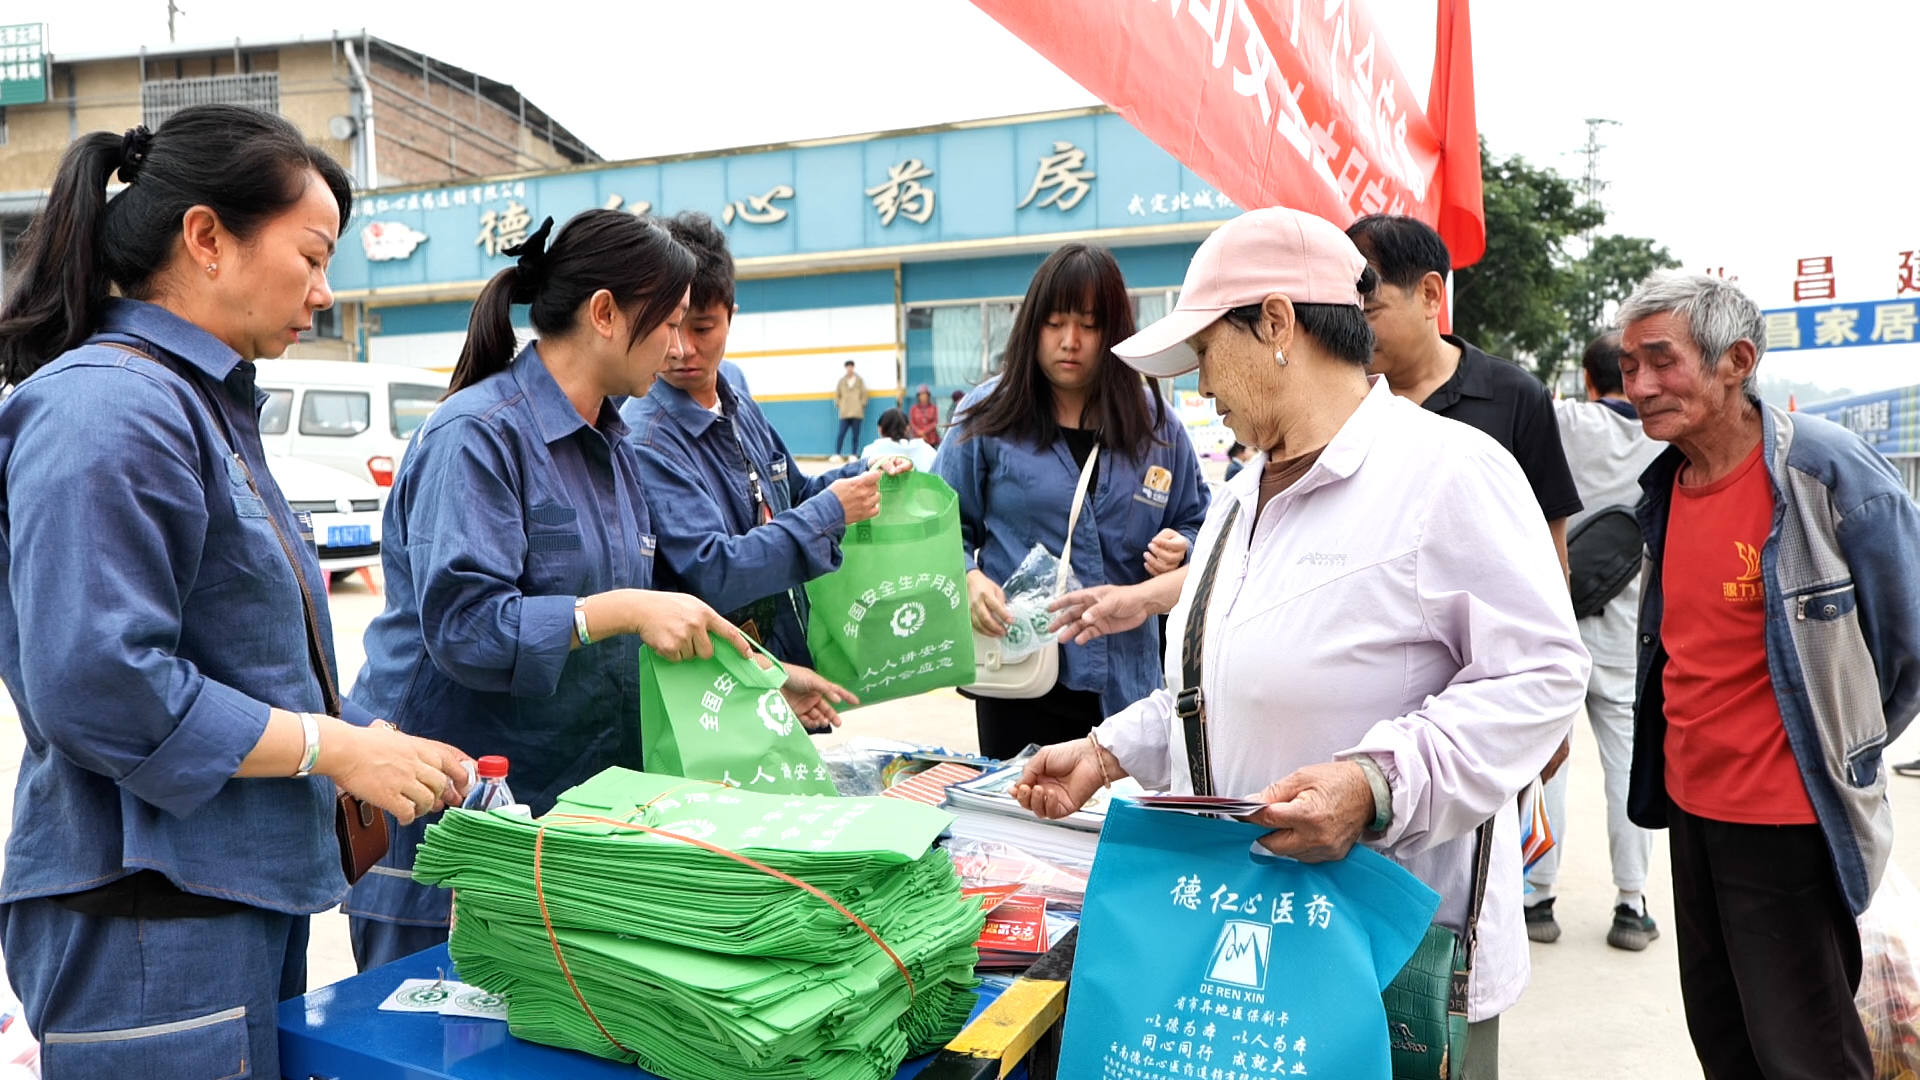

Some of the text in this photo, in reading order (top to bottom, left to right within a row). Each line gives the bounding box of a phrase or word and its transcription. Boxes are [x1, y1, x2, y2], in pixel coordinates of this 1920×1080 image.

[843, 572, 961, 639] 全国安全生产月活动
[859, 657, 954, 694] 个个会应急
[861, 639, 955, 681] 人人讲安全
[1170, 874, 1334, 930] 德仁心医药
[1174, 995, 1289, 1027] 省市异地医保刷卡
[1200, 983, 1265, 1004] DE REN XIN
[1142, 1033, 1308, 1076] 同心同行 成就大业
[1145, 1013, 1307, 1056] 以德为本 以人为本
[1110, 1041, 1278, 1080] 云南德仁心医药连锁有
